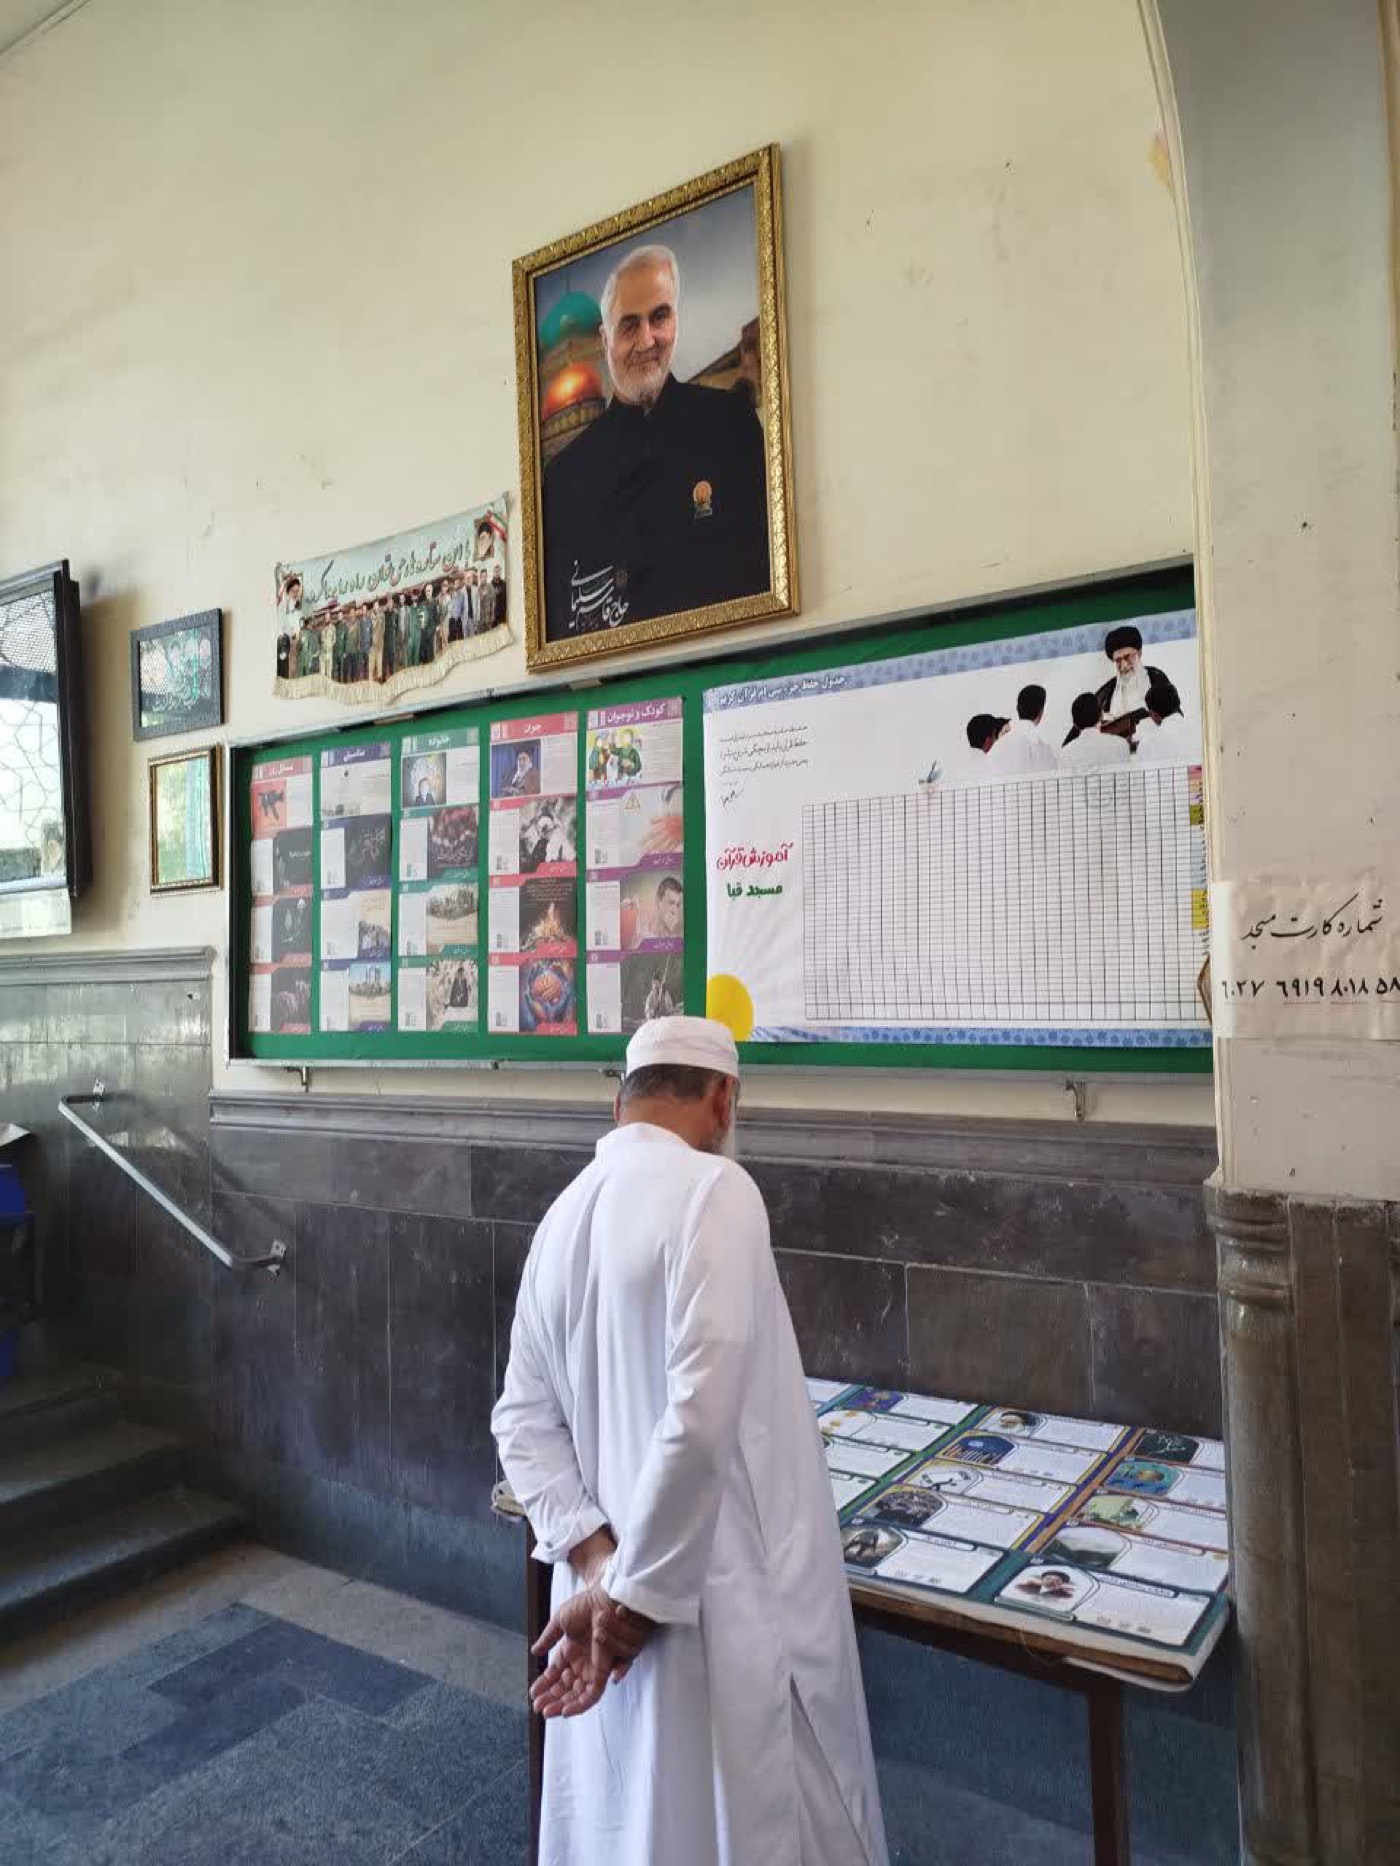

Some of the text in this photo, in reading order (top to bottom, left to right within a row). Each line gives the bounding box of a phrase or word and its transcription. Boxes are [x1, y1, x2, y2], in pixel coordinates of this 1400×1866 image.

[607, 706, 635, 724] نوجوان
[641, 702, 666, 719] کودک
[716, 842, 794, 871] آموزش قرآن
[726, 881, 783, 901] مسجد قبا
[1240, 892, 1384, 951] شماره کارت مسجد
